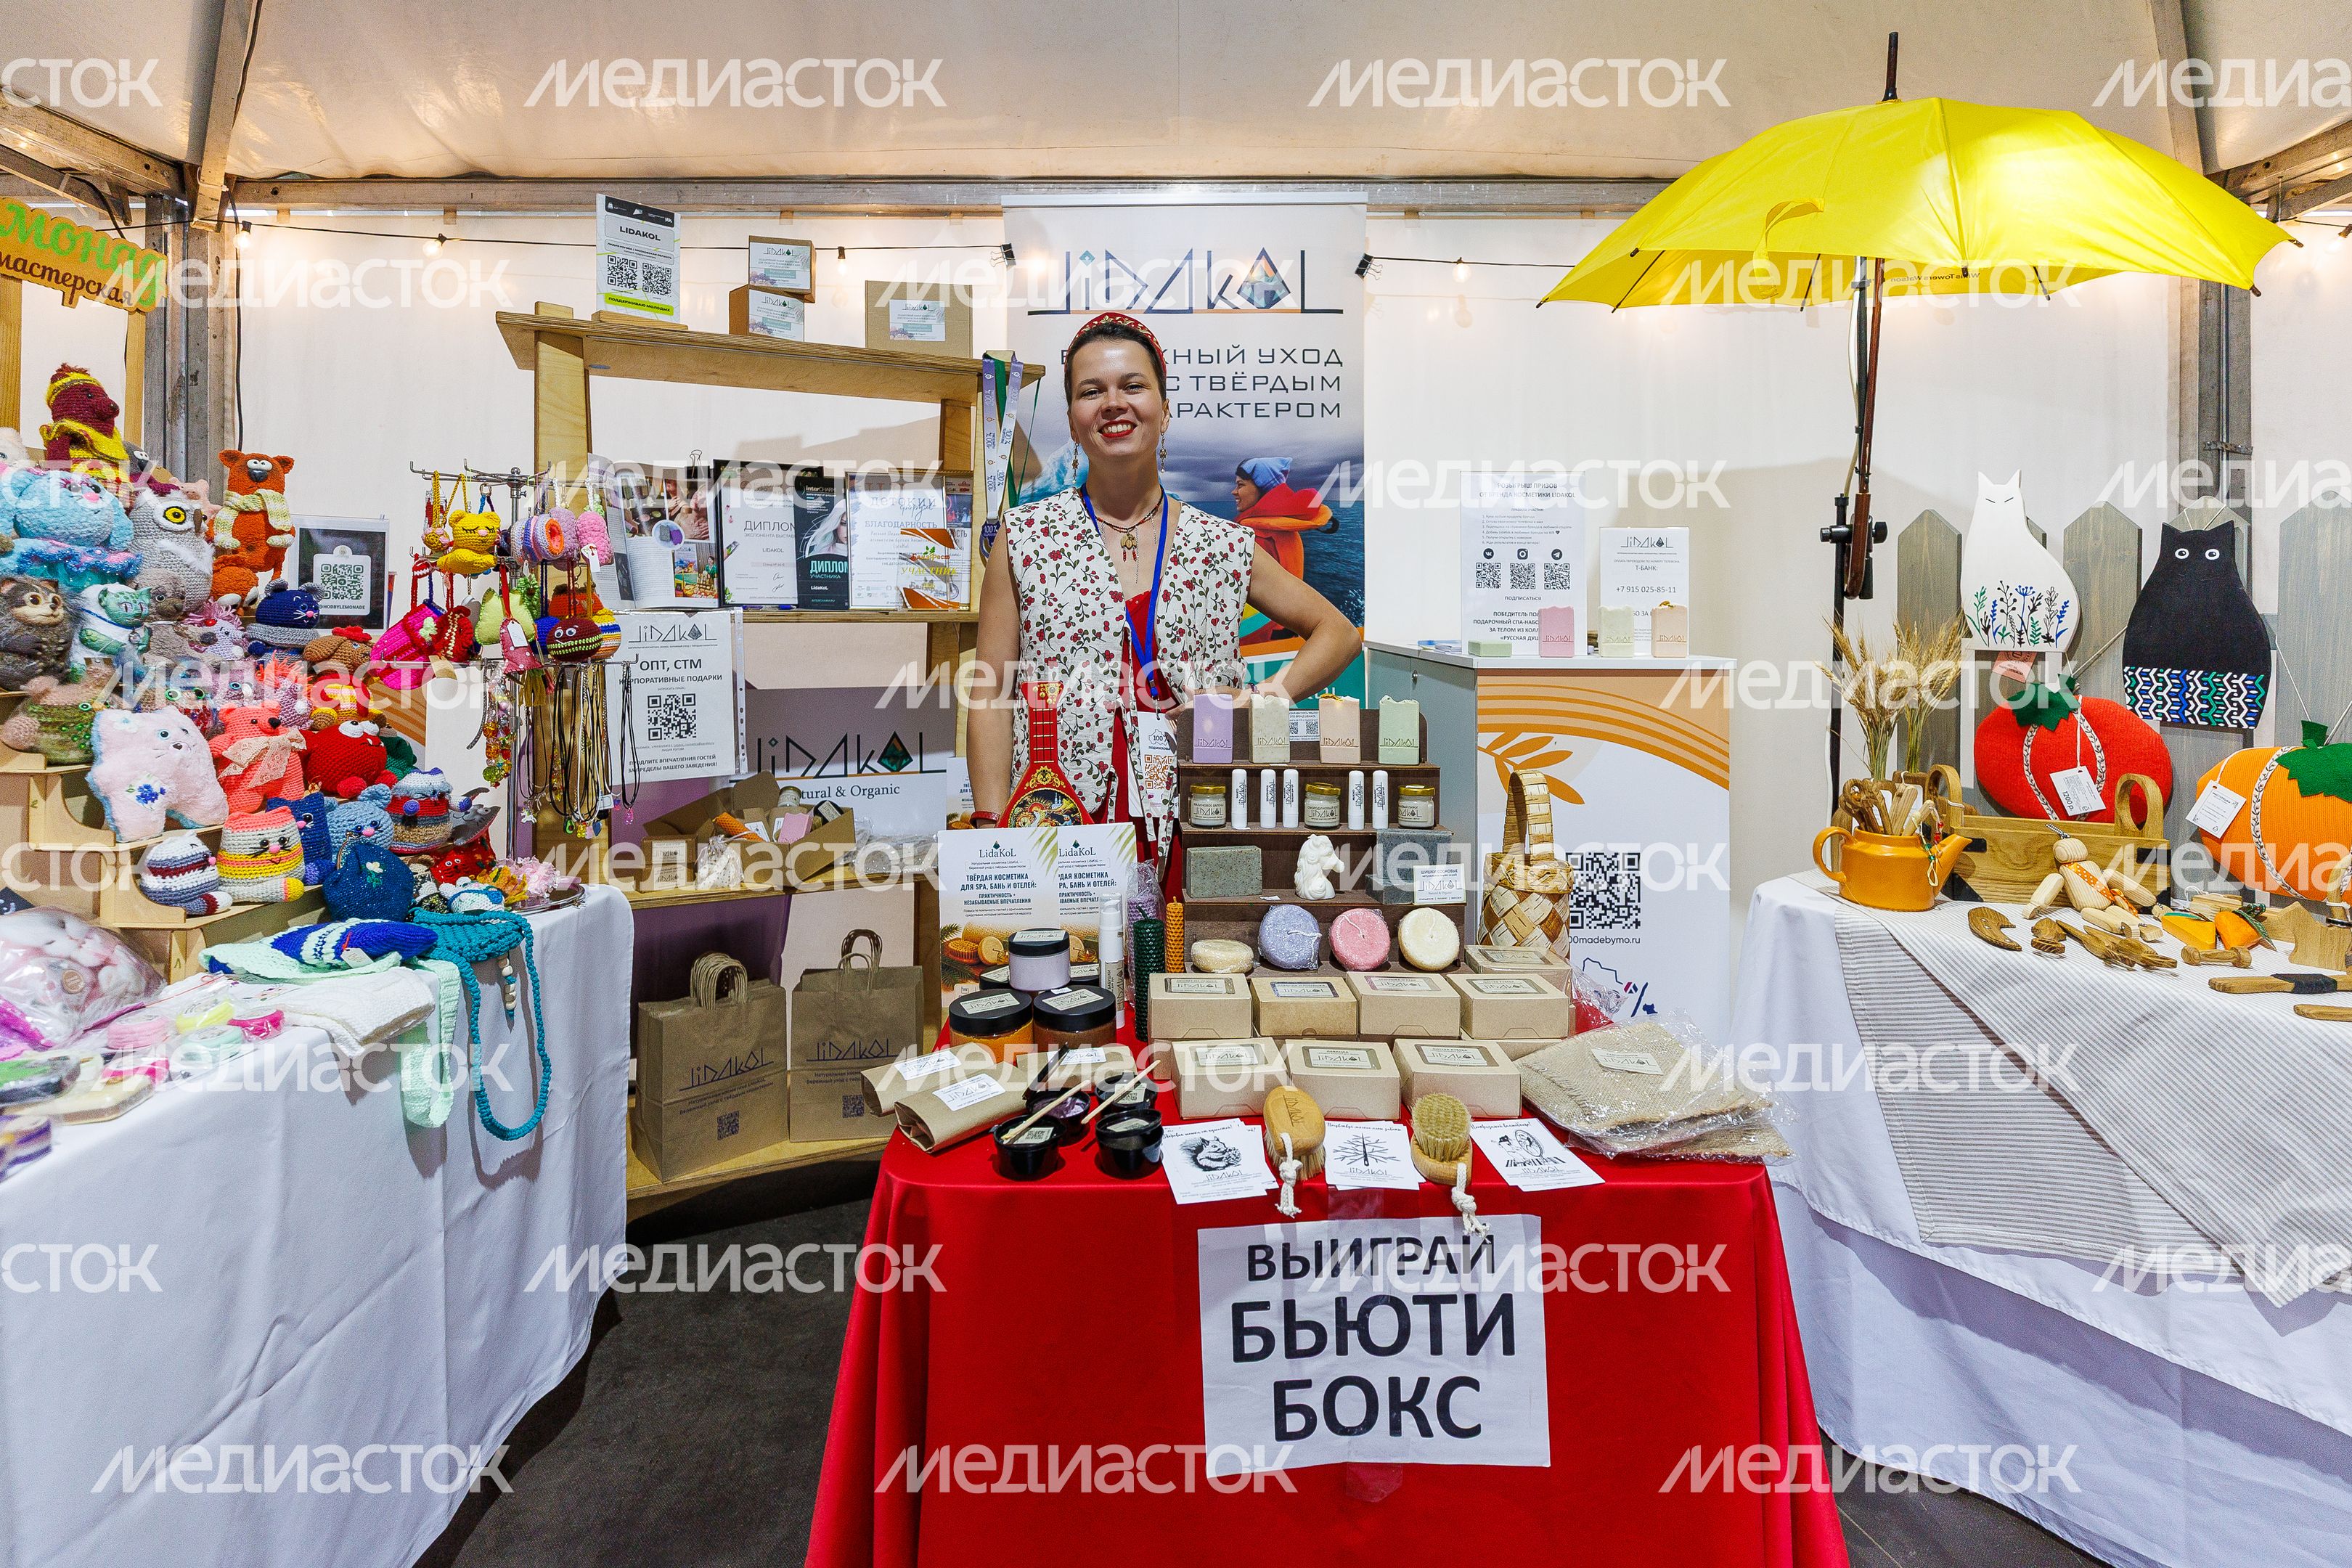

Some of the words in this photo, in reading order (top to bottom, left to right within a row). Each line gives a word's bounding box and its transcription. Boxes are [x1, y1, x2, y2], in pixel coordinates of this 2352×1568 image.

[619, 226, 661, 242] LIDAKOL
[635, 248, 657, 256] МОСКОВСКАЯ
[608, 296, 646, 309] ПОДДЕРЖИВАЮ
[646, 303, 671, 313] МОЛОДЫХ
[1258, 348, 1344, 367] УХОД
[1190, 372, 1341, 393] ТВЁРДЫМ
[1169, 402, 1341, 419] РАКТЕРОМ
[901, 567, 958, 576] УЧАСТНИК
[640, 660, 670, 672] ОПТ,
[674, 658, 702, 669] СТМ
[618, 676, 685, 685] КРПОРАТИВНЫЕ
[801, 786, 832, 799] tural
[835, 785, 846, 797] &
[850, 783, 900, 800] Organic
[2062, 791, 2073, 805] 1200
[979, 848, 1016, 858] LidaKoL
[1058, 847, 1096, 857] LidaKoL
[966, 873, 992, 882] ТВЁРДАЯ
[1093, 879, 1117, 888] ОТЕЛЕЙ:
[1013, 881, 1037, 889] ОТЕЛЕЙ:
[1568, 935, 1641, 947] 00madebymo.ru
[1247, 1223, 1495, 1282] ВЫИГРАЙ
[1231, 1293, 1516, 1363] БЬЮТИ
[1273, 1375, 1482, 1442] БОКС
